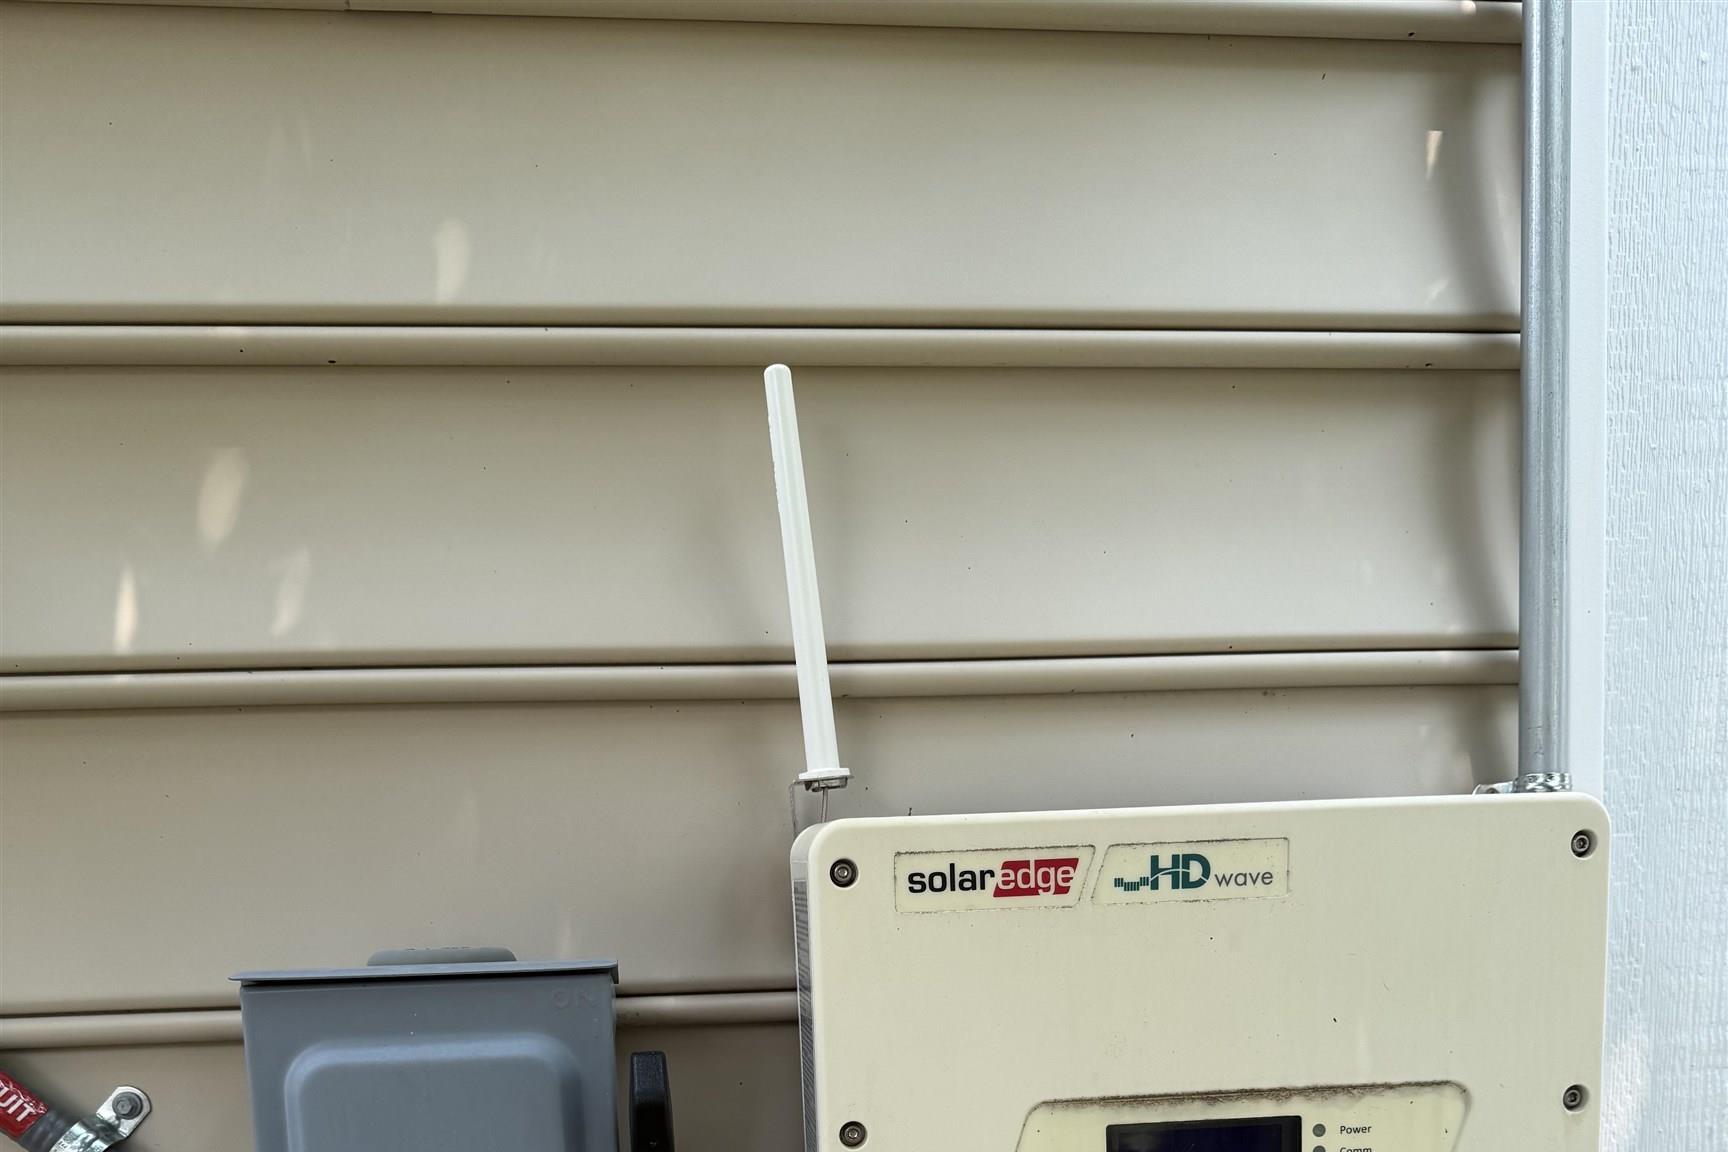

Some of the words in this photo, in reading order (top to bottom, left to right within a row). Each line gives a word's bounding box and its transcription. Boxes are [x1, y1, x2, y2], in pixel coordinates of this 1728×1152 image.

[908, 859, 1074, 896] solaredge
[1150, 854, 1211, 890] HD
[1214, 868, 1274, 888] wave
[0, 1079, 37, 1122] UIT
[1339, 1125, 1372, 1135] Power
